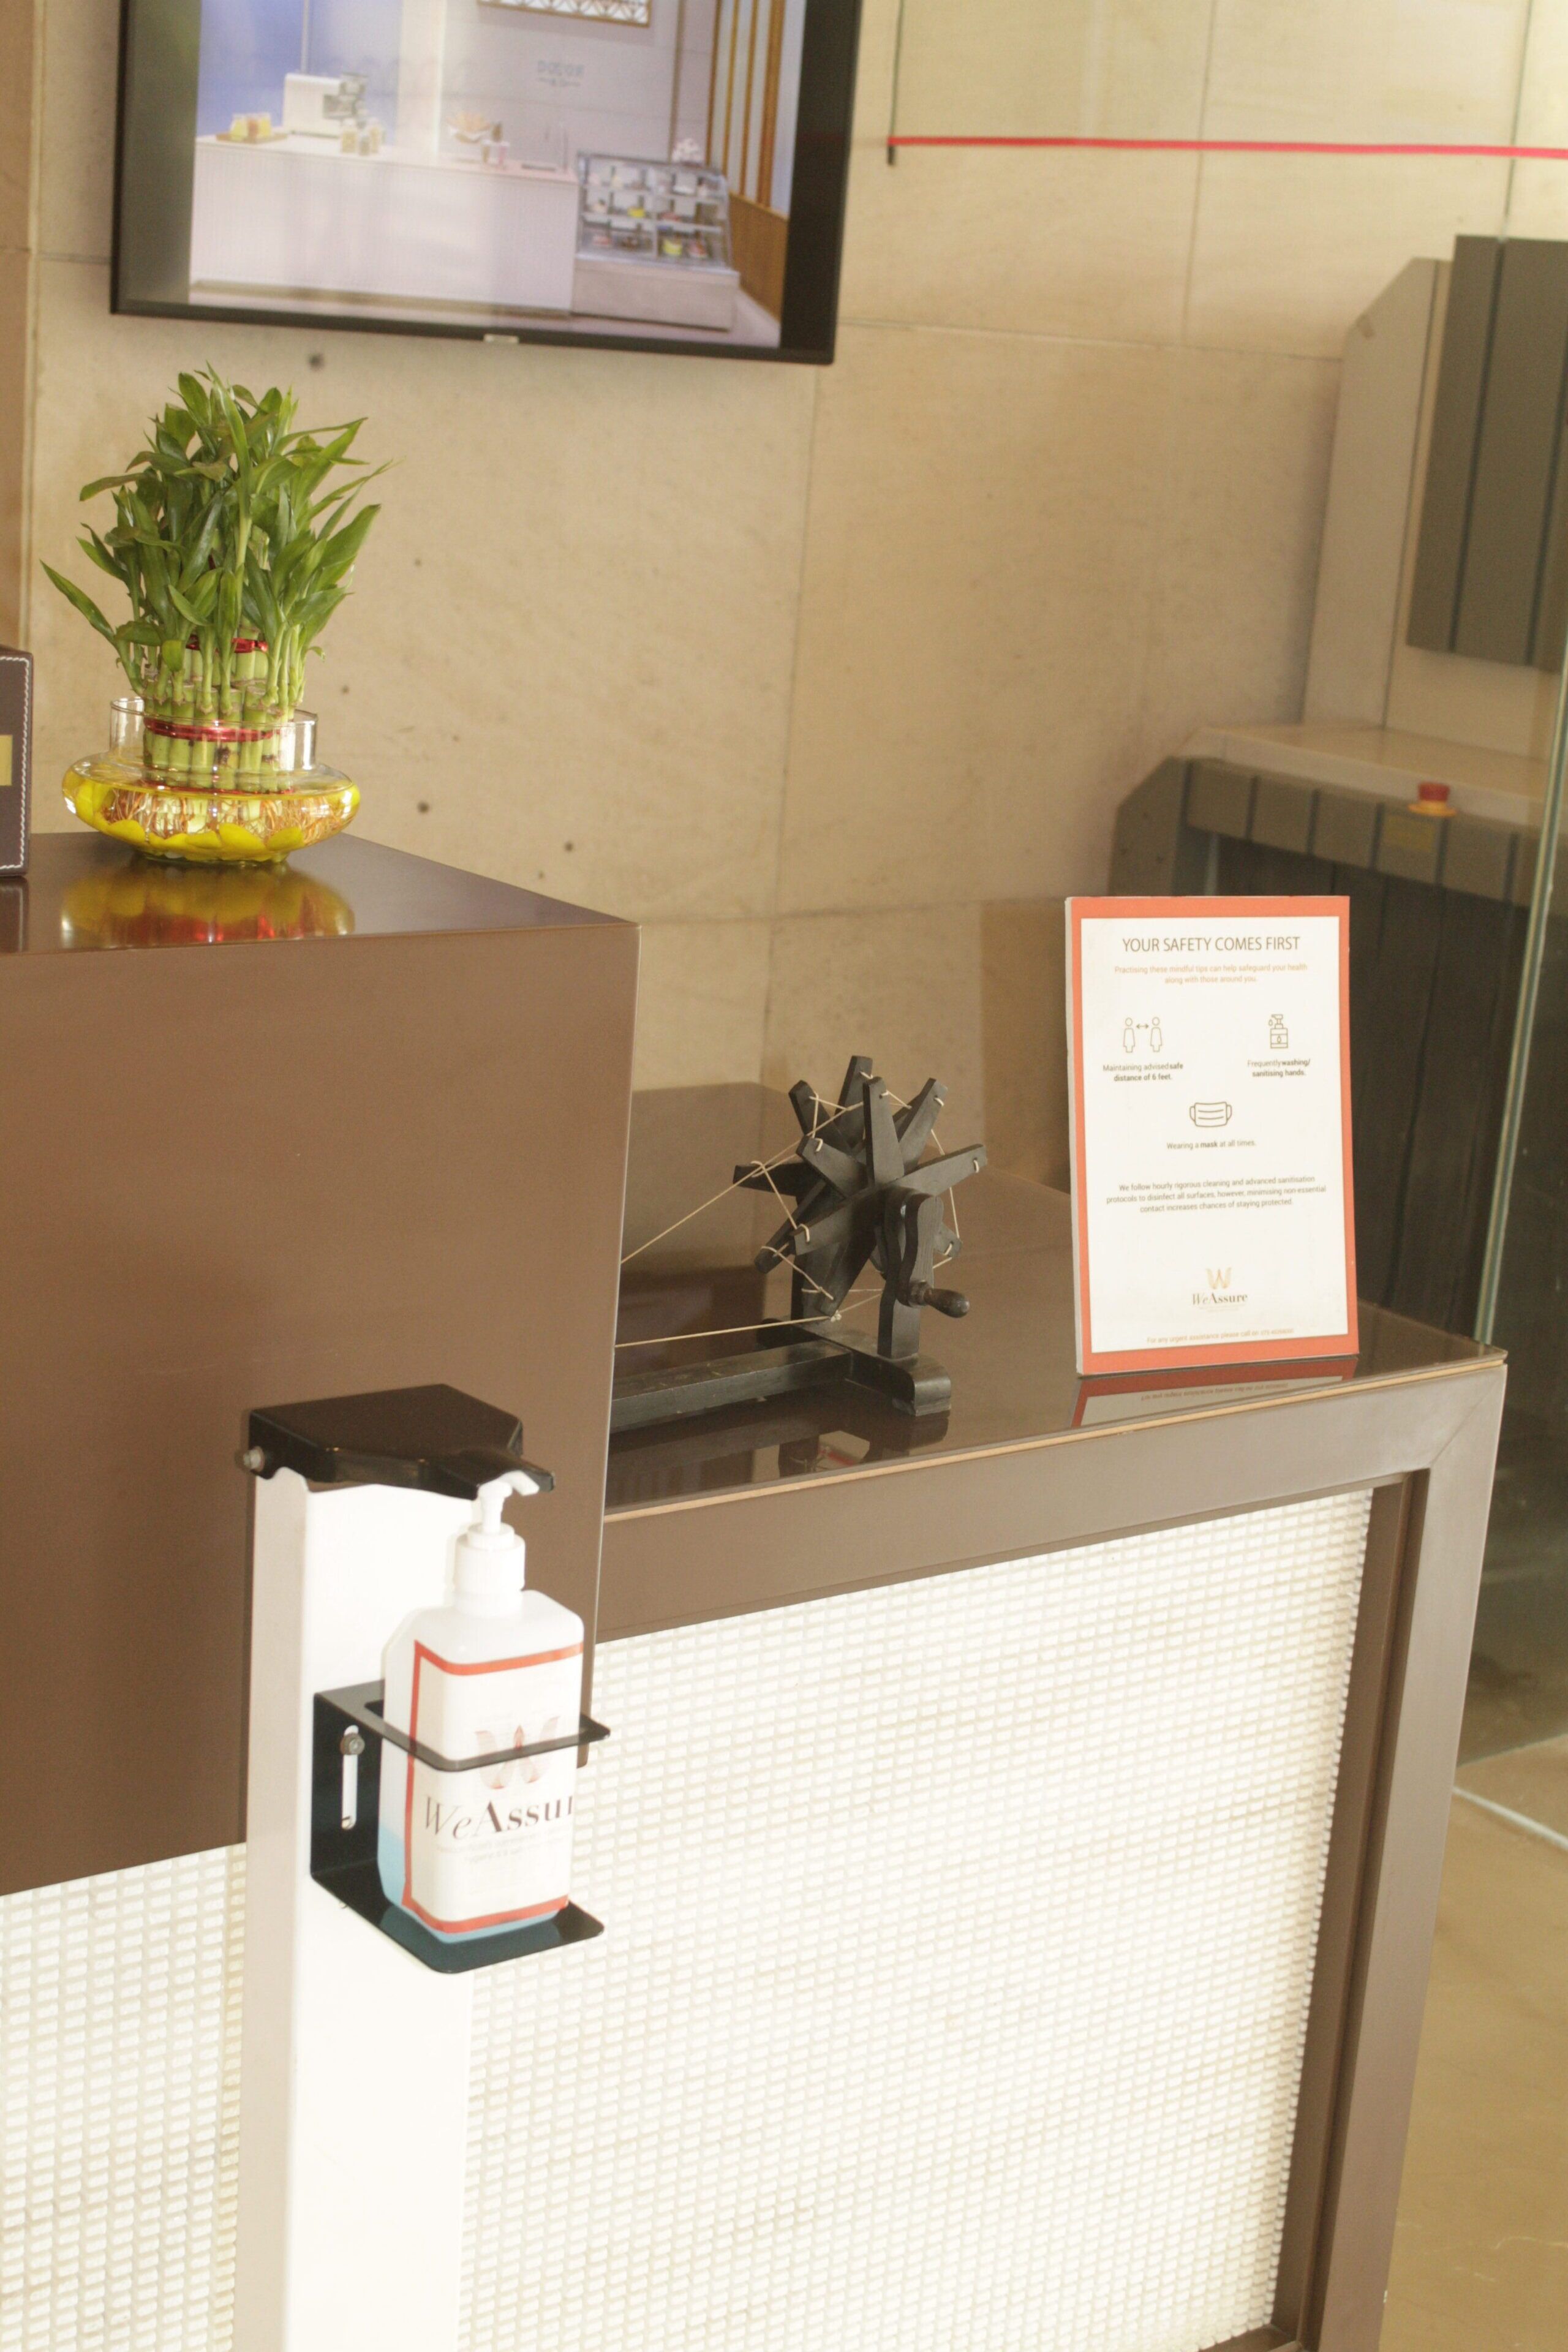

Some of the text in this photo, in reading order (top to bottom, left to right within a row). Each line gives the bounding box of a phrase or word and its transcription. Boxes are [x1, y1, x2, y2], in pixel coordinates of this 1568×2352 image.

[1123, 937, 1300, 951] YOUR SAFETY COMES FIRST
[1115, 966, 1147, 975] Practising
[1196, 965, 1207, 974] tips
[1223, 964, 1236, 973] help
[1239, 963, 1270, 973] safeguard
[1165, 976, 1183, 985] along
[1103, 1064, 1142, 1072] Maintaining
[1248, 1058, 1311, 1068] Frequently washing/
[1153, 1182, 1173, 1191] hourly
[1174, 1180, 1201, 1191] rigorous
[1203, 1179, 1230, 1189] cleaning
[1278, 1175, 1315, 1184] sanitisation
[1107, 1195, 1137, 1204] protocols
[1147, 1193, 1175, 1201] disinfect
[1247, 1187, 1282, 1197] minimising
[1140, 1204, 1164, 1213] contact
[1199, 1201, 1226, 1210] chances
[1237, 1200, 1260, 1208] staying
[1192, 1293, 1248, 1305] WeAssure
